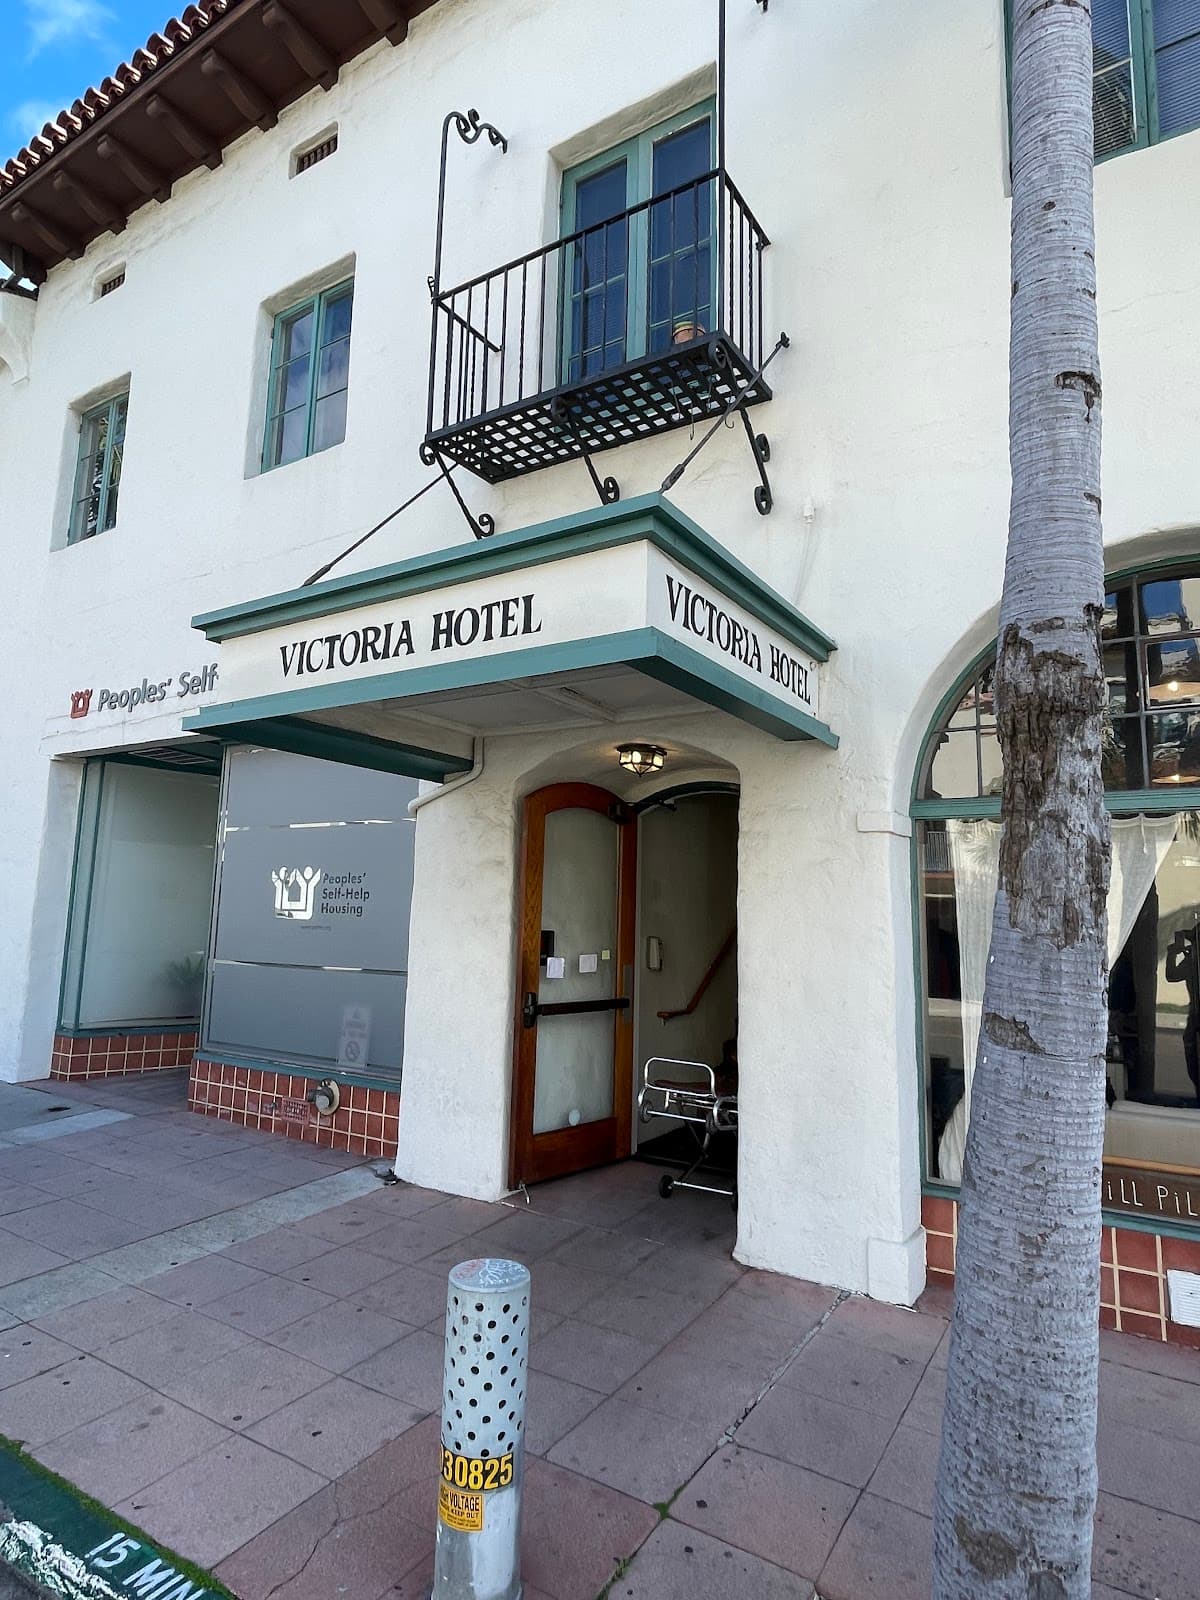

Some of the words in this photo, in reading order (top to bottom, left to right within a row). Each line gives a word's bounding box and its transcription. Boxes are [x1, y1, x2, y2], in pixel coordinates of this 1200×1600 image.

[279, 620, 416, 677] VICTORIA
[430, 593, 543, 652] HOTEL
[666, 574, 762, 673] VICTORIA
[769, 643, 811, 705] HOTEL
[97, 678, 173, 713] Peoples'
[322, 872, 367, 887] Peoples'
[321, 887, 370, 902] Self-Help
[320, 902, 363, 917] Housing
[449, 1490, 480, 1512] VOLTAGE
[84, 1532, 142, 1568] 15
